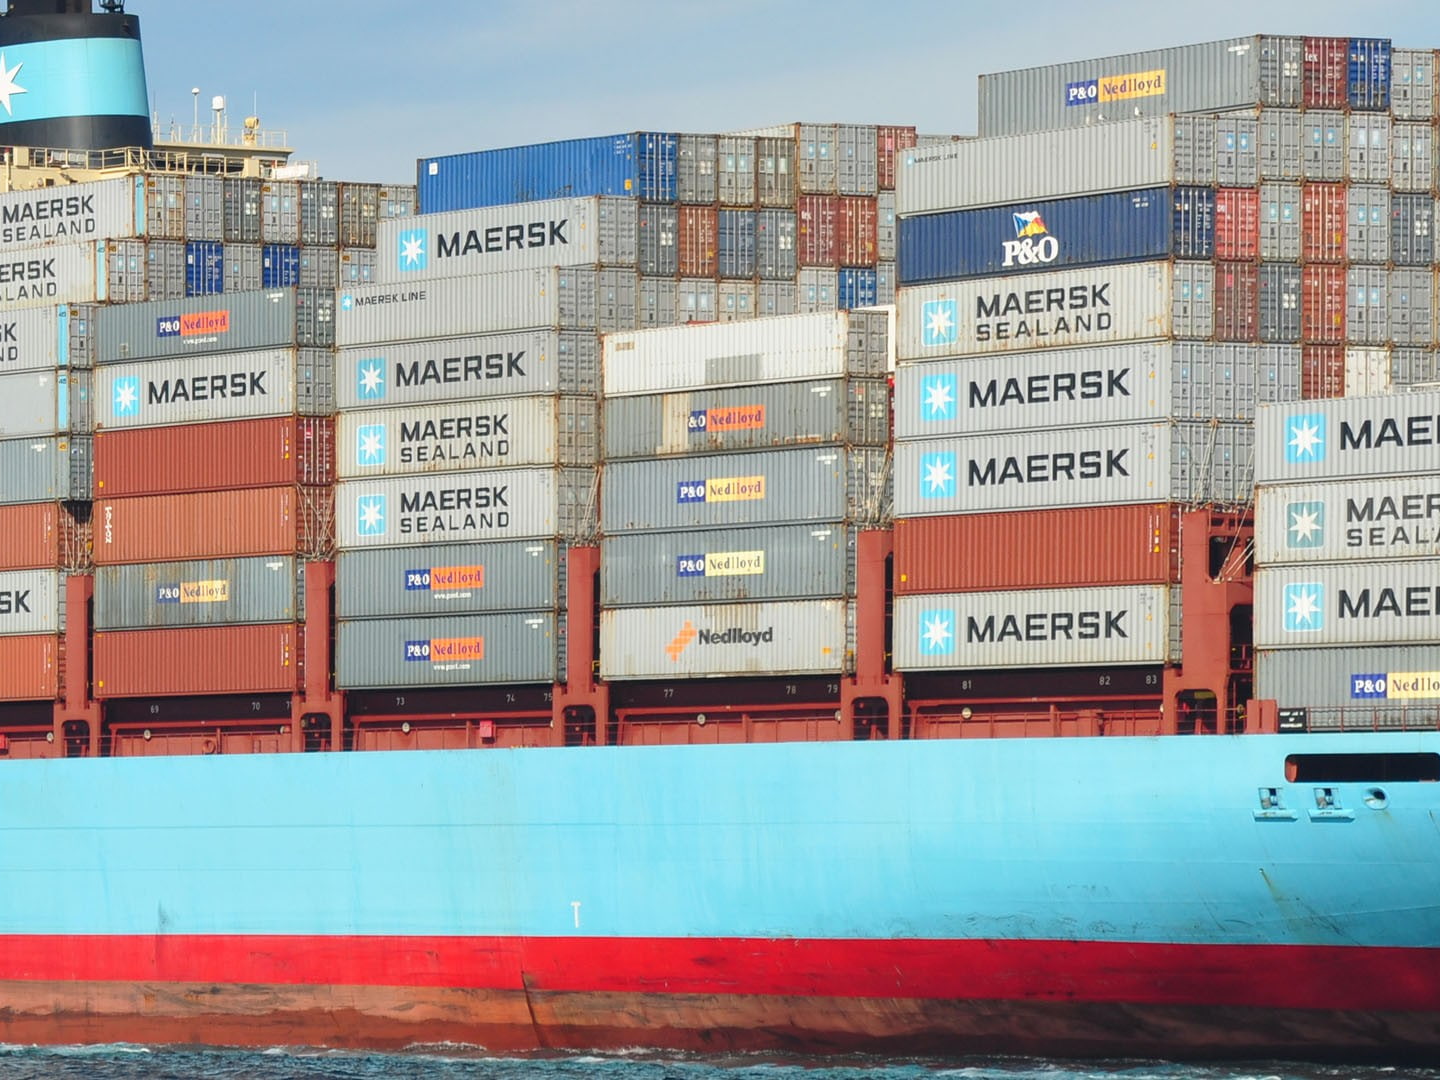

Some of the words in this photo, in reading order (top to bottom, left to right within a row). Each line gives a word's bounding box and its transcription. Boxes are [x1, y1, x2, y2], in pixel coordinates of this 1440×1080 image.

[1069, 85, 1097, 101] P&O
[1103, 73, 1163, 96] Nedlloyd
[2, 194, 94, 225] MAERSK
[2, 218, 96, 243] SEALAND
[436, 220, 568, 258] MAERSK
[1003, 236, 1059, 266] P&O
[355, 293, 398, 306] MAERSK
[402, 291, 426, 302] LINE
[976, 283, 1111, 319] MAERSK
[159, 318, 180, 333] P&O
[183, 311, 227, 333] Nedlloyd
[976, 312, 1112, 342] SEALAND
[395, 351, 526, 388] MAERSK
[148, 371, 267, 404] MAERSK
[969, 368, 1130, 408] MAERSK
[710, 409, 763, 427] Nedlloyd
[400, 414, 508, 442] MAERSK
[401, 440, 509, 463] SEALAND
[968, 449, 1129, 487] MAERSK
[680, 484, 704, 498] P&O
[709, 480, 763, 498] Nedlloyd
[400, 487, 508, 513] MAERSK
[401, 511, 509, 534] SEALAND
[680, 558, 704, 572] P&O
[709, 554, 763, 572] Nedlloyd
[408, 573, 429, 587] P&O
[433, 568, 482, 587] Nedlloyd
[159, 585, 179, 599] P&O
[183, 581, 227, 600] Nedlloyd
[967, 610, 1128, 643] MAERSK
[698, 628, 773, 647] Nedlloyd
[408, 643, 429, 658] P&O
[433, 640, 482, 658] Nedlloyd
[962, 680, 972, 690] 81
[1099, 676, 1110, 686] 82
[1146, 675, 1157, 684] 83
[1355, 678, 1385, 694] P&O
[507, 695, 515, 703] 74
[664, 689, 674, 698] 77
[786, 686, 796, 695] 78
[828, 685, 838, 694] 79
[150, 704, 159, 713] 69
[252, 701, 260, 711] 70
[396, 698, 405, 706] 73
